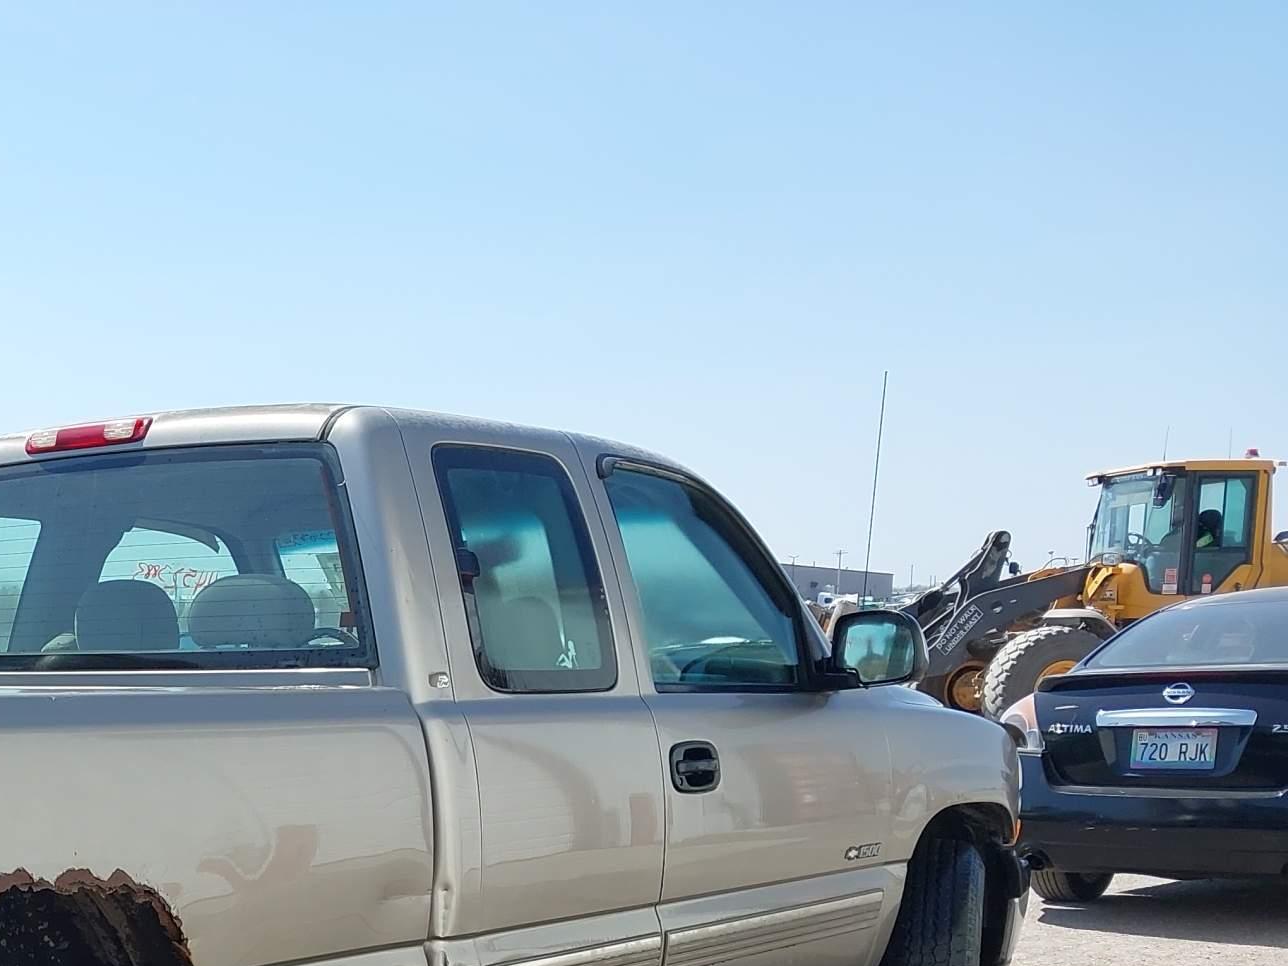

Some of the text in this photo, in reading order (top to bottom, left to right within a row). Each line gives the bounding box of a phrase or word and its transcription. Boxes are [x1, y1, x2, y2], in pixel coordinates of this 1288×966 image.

[936, 606, 977, 650] DO NOT WALK
[944, 630, 966, 652] UNDER
[1048, 723, 1092, 734] ALTIMA
[1154, 732, 1198, 740] KANSAS
[1140, 742, 1209, 761] 720 RJK
